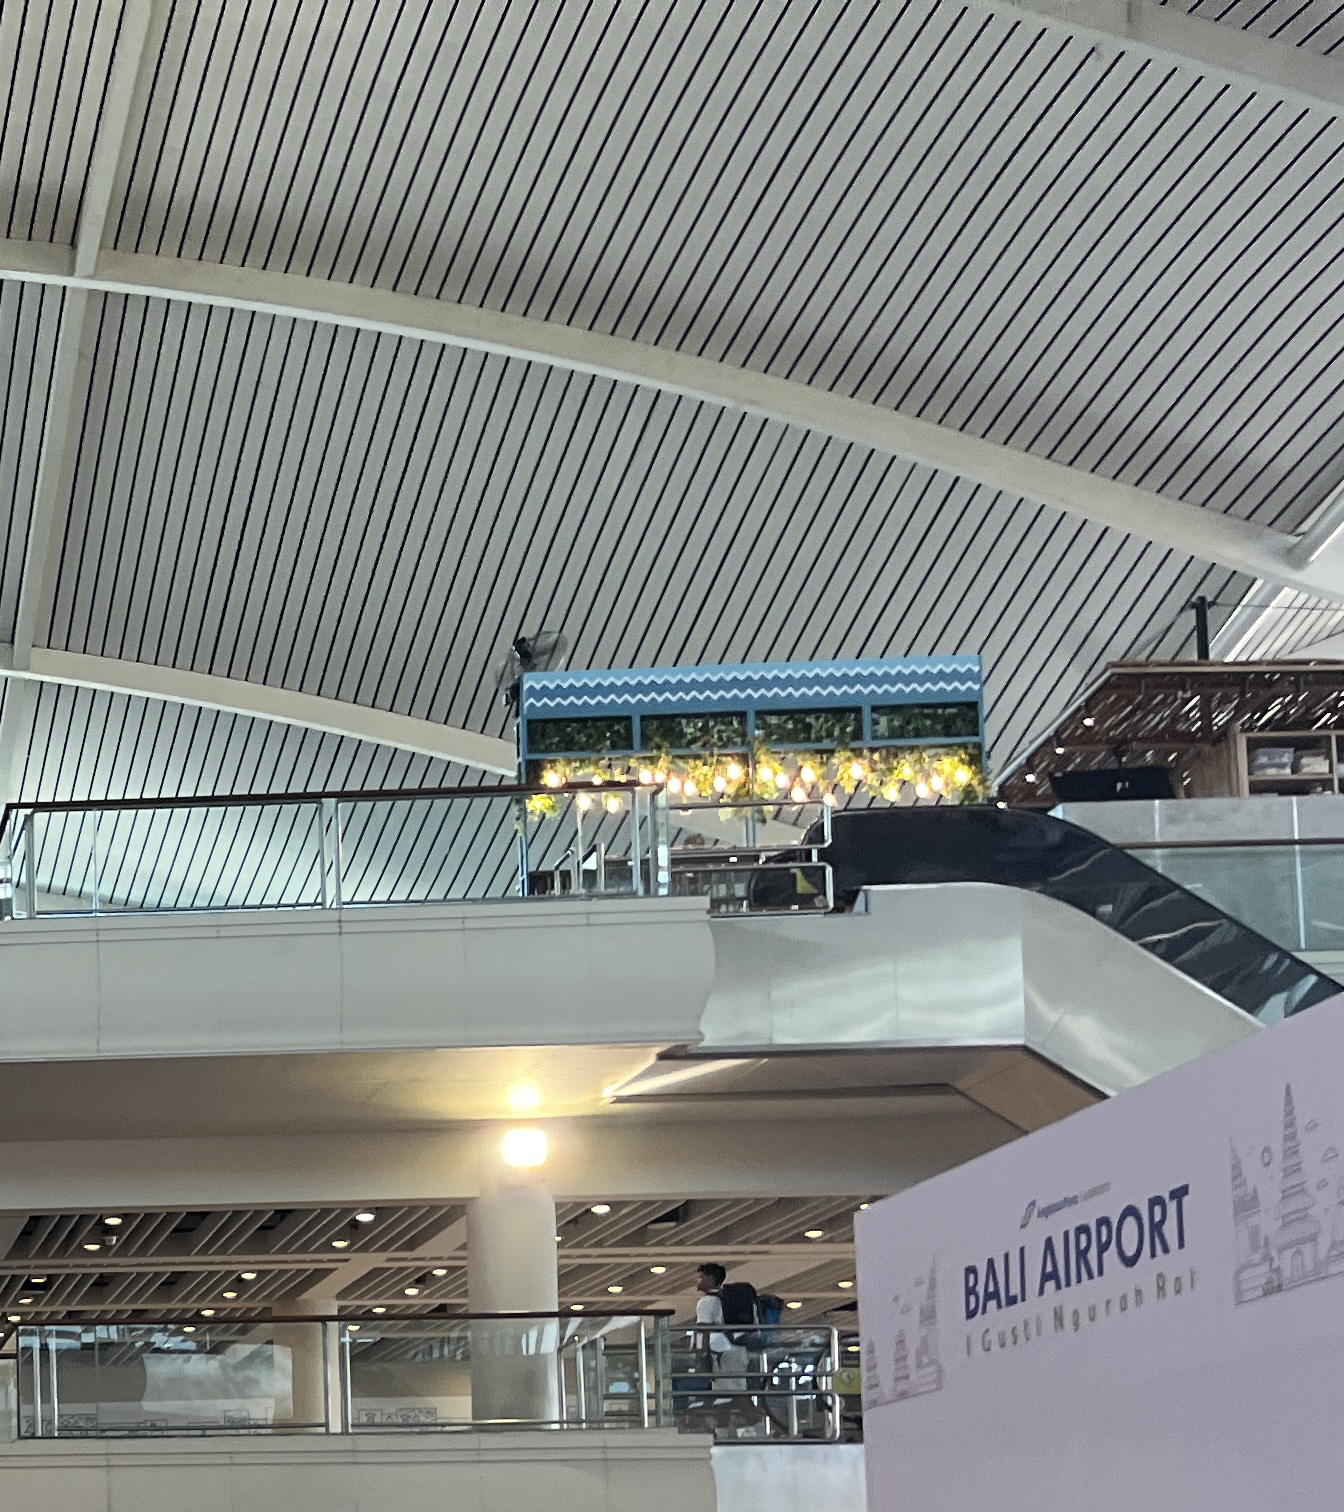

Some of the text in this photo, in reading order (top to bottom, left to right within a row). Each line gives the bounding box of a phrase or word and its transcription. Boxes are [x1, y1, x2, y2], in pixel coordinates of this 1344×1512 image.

[964, 1183, 1190, 1320] BALI AIRPORT
[981, 1318, 1042, 1354] Gusti
[1053, 1284, 1144, 1335] Ngurah
[1156, 1267, 1197, 1300] Rai
